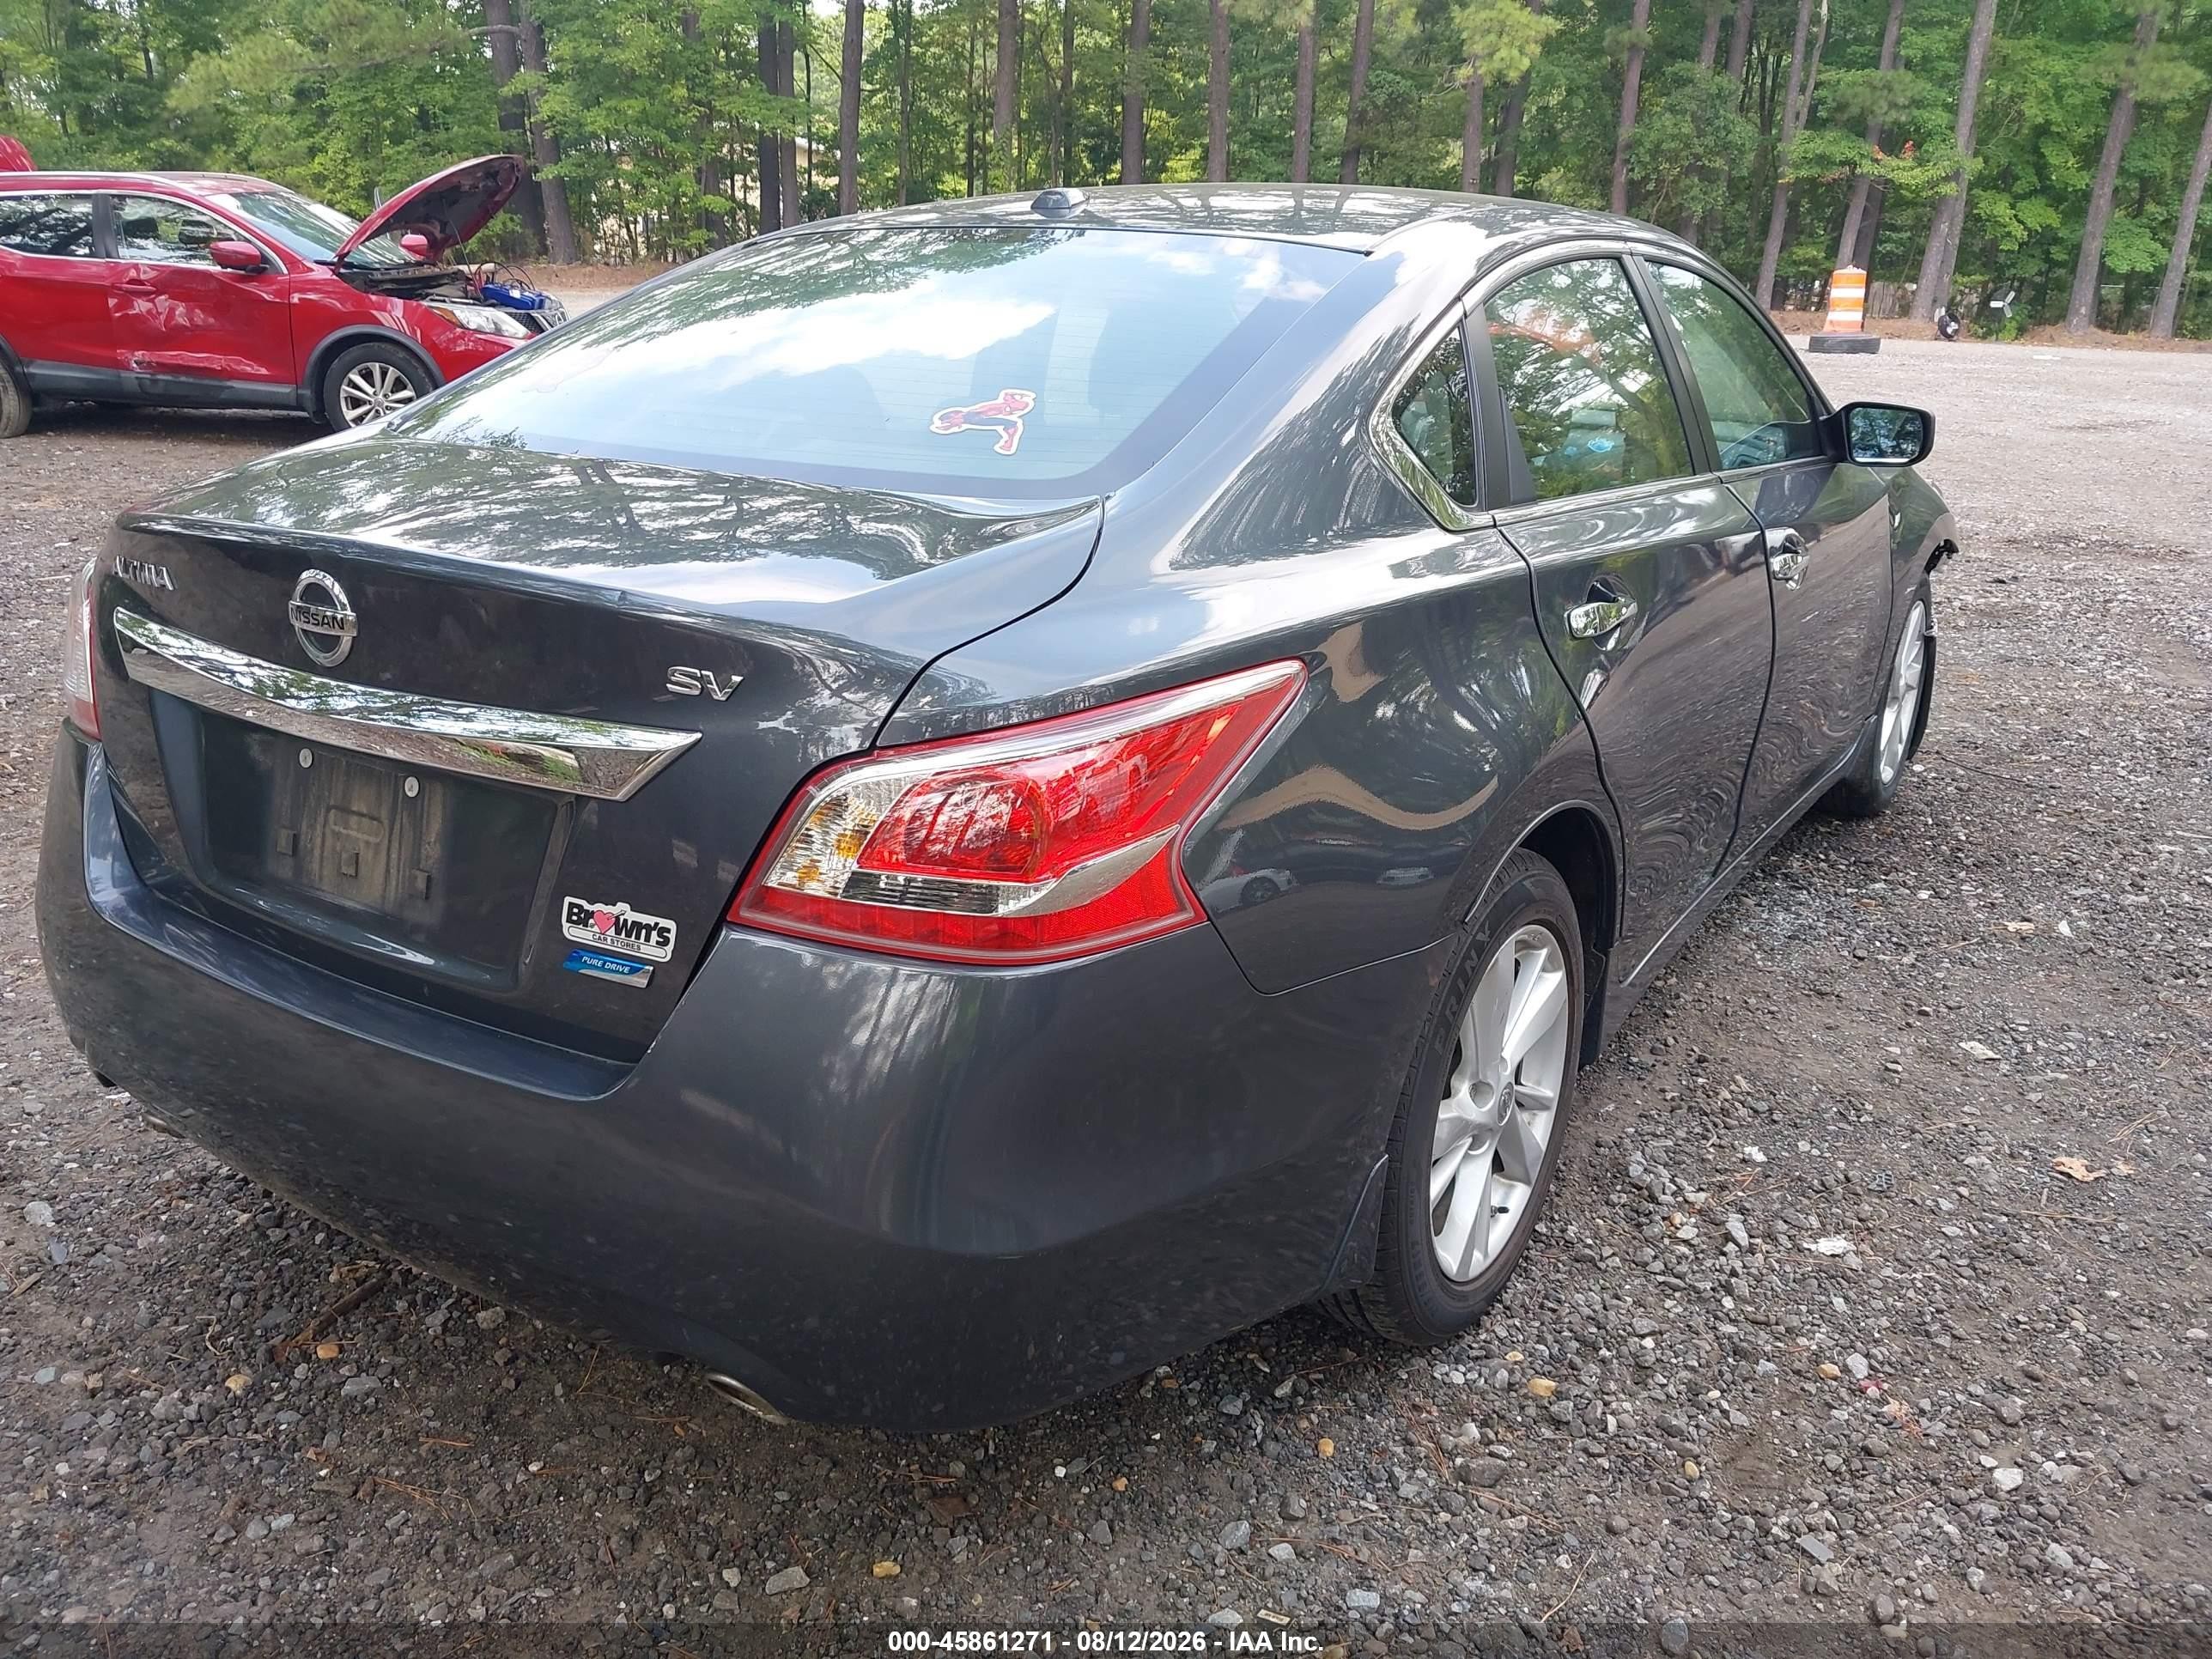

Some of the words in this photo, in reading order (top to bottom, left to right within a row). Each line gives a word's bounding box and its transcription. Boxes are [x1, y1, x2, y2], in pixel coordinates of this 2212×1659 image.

[290, 607, 345, 631] NISSAN
[665, 665, 744, 702] SV
[592, 933, 609, 945] CAR
[610, 939, 642, 951] STORES
[581, 956, 603, 968] PURE
[604, 962, 631, 975] DRIVE
